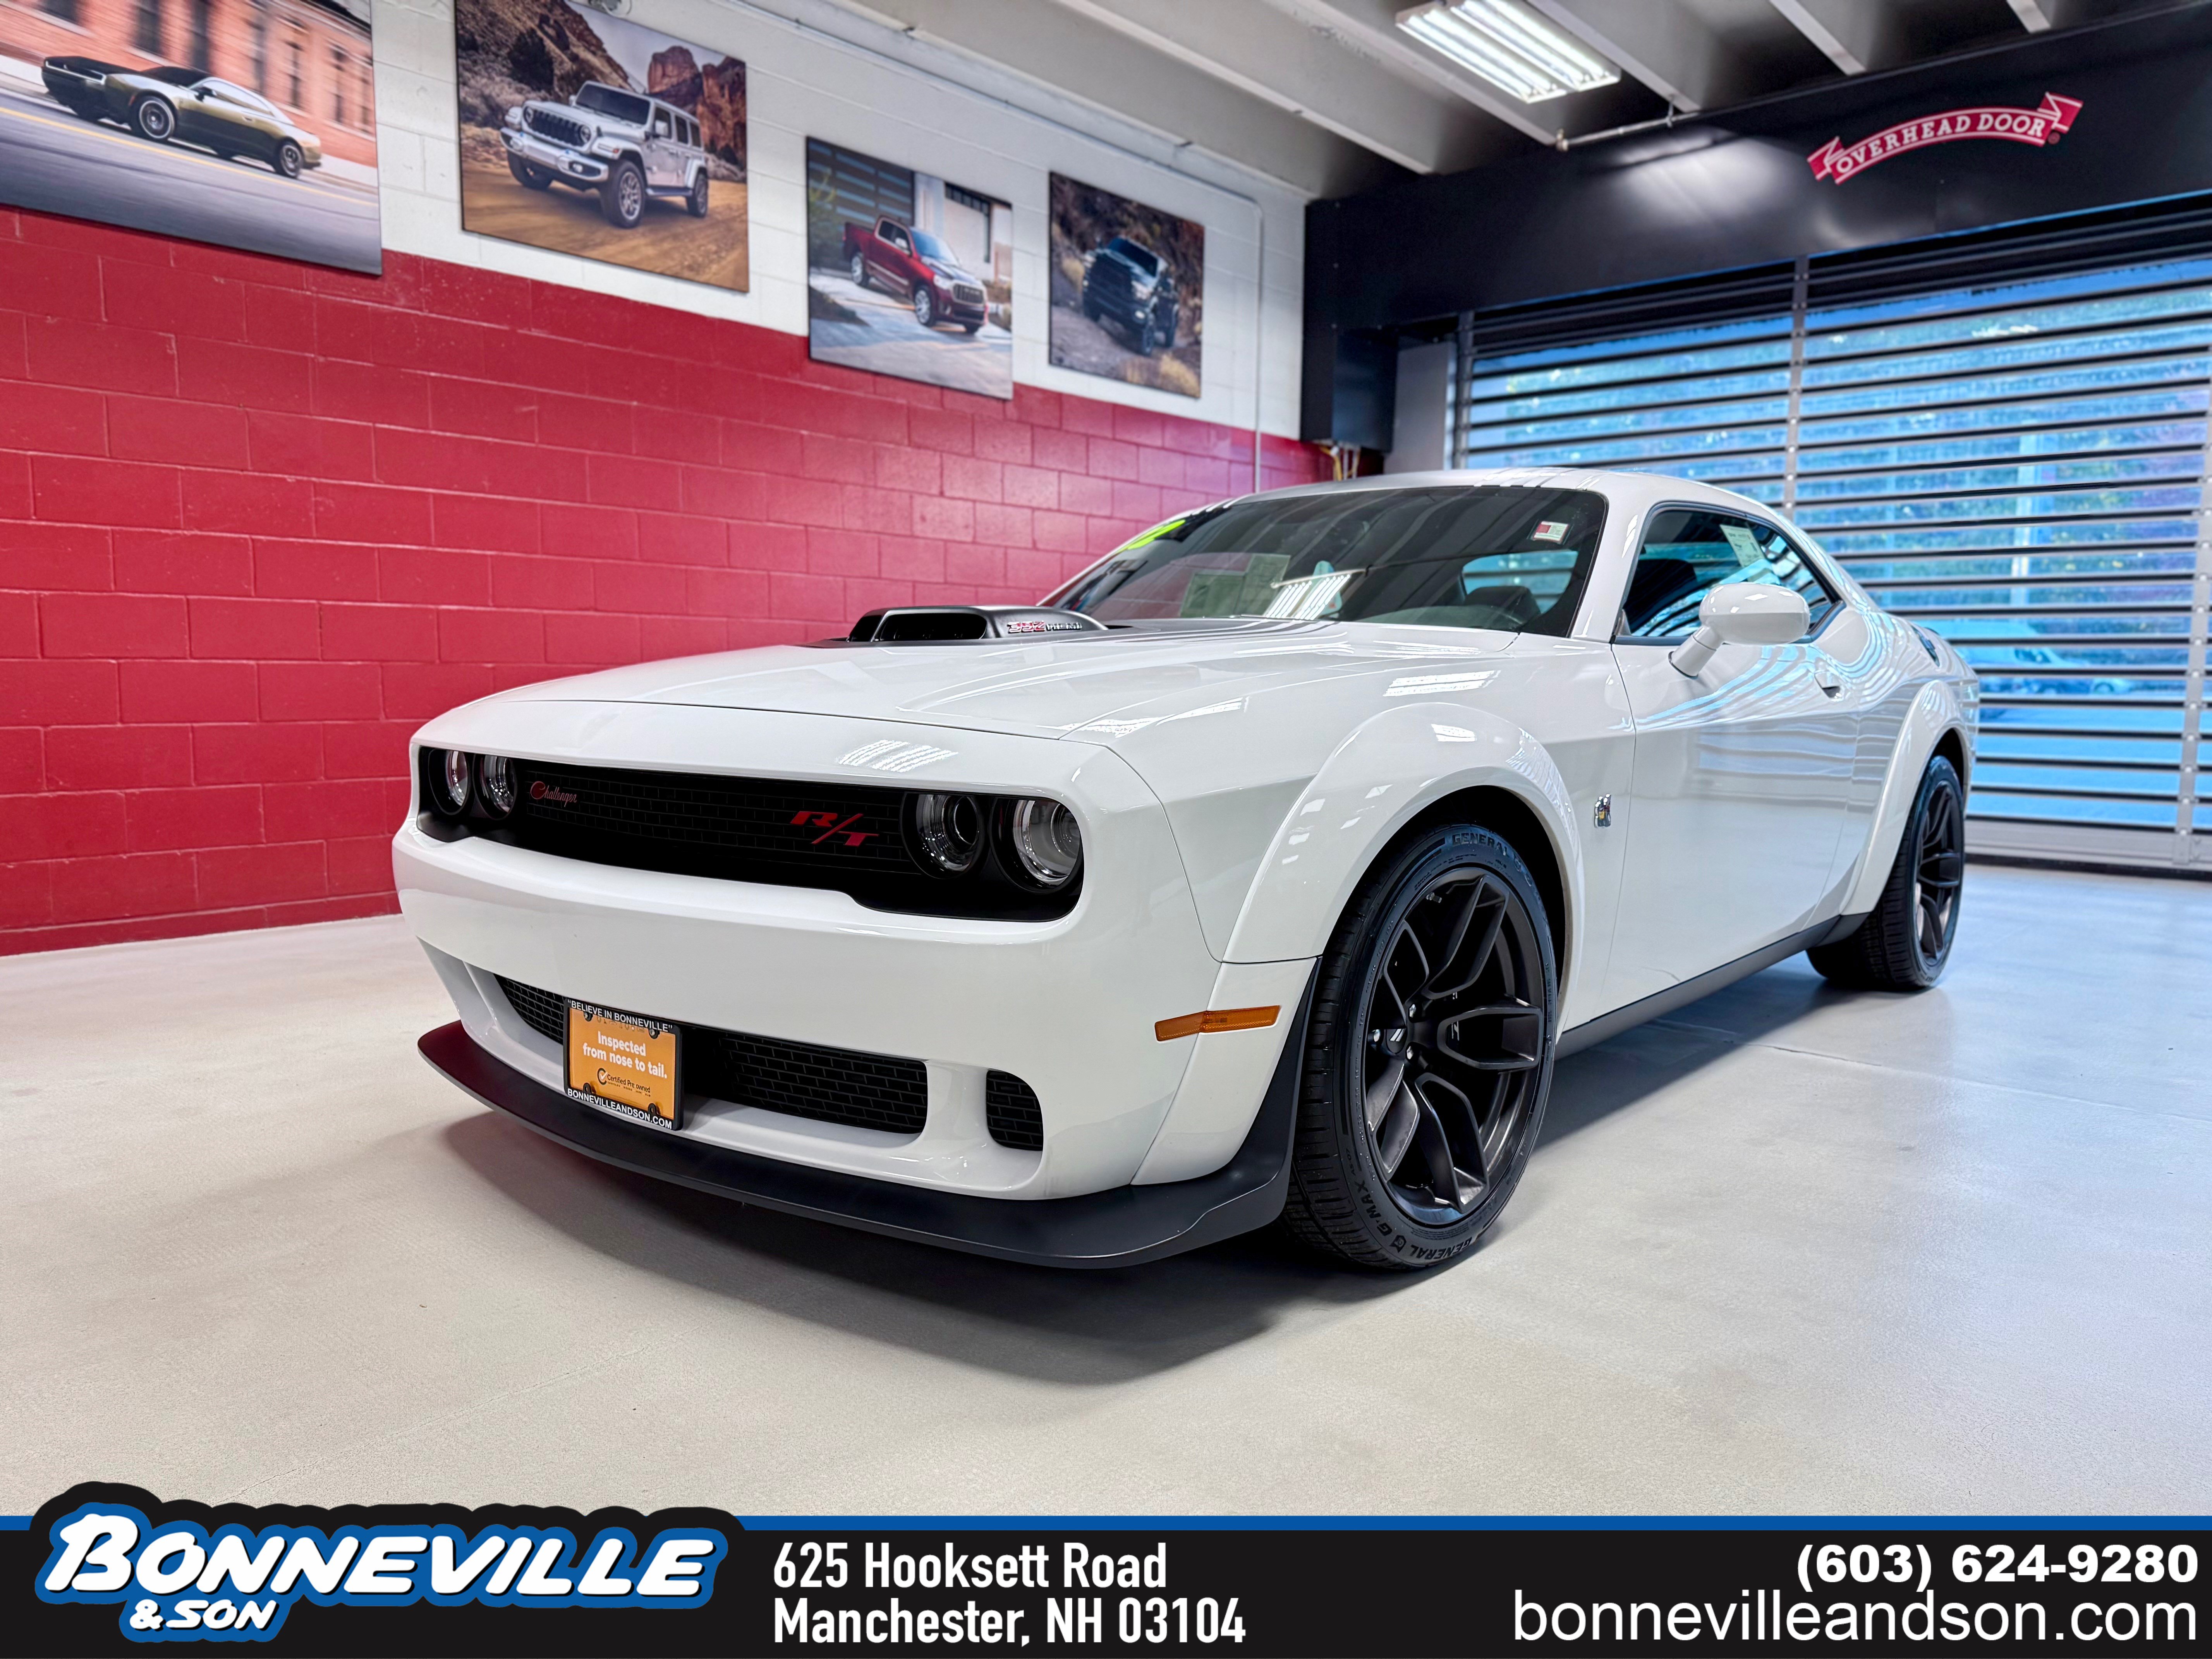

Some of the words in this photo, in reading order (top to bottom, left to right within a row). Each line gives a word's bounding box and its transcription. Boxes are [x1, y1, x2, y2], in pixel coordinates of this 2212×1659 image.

[1836, 115, 1971, 173] OVERHEAD
[1977, 113, 2046, 137] DOOR
[530, 781, 577, 807] Challenger
[790, 811, 879, 847] R/T
[1452, 833, 1510, 858] GENERAL
[605, 1010, 612, 1020] IN
[598, 1031, 646, 1056] Inspected
[583, 1042, 607, 1061] from
[610, 1052, 633, 1068] nose
[635, 1057, 645, 1072] to
[648, 1061, 667, 1079] tail.
[607, 1074, 626, 1085] Certified
[635, 1084, 651, 1093] owned
[568, 1088, 672, 1130] BONNEVILLEANDSON.COM
[1410, 1237, 1472, 1260] GENERAL
